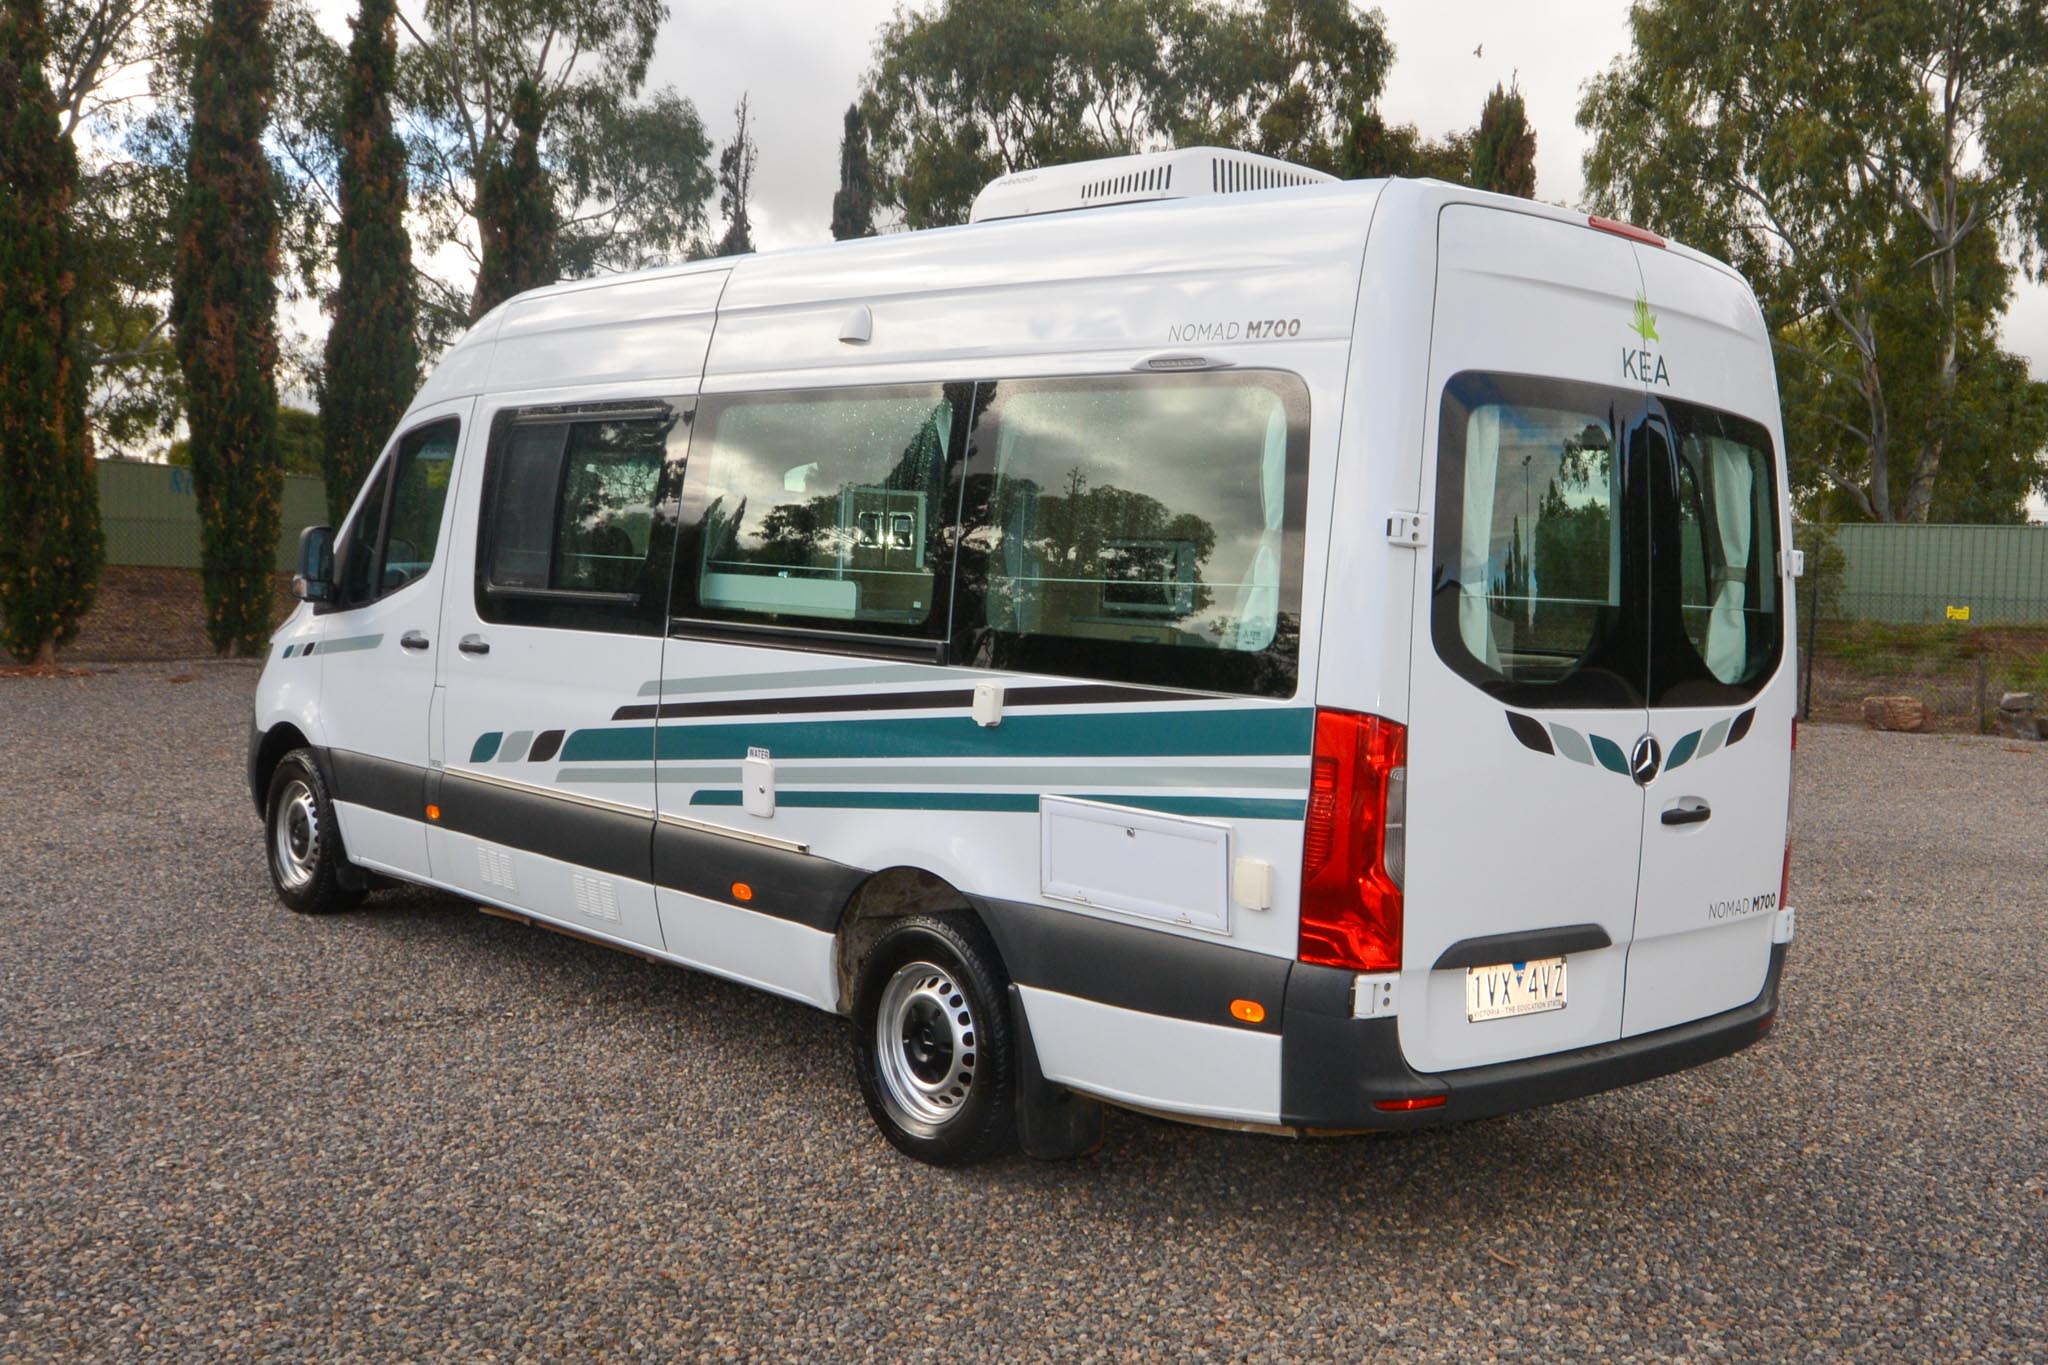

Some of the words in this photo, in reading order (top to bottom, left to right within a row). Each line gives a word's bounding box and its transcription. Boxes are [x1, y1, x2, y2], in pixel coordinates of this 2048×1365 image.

[1168, 321, 1240, 343] NOMAD
[1246, 318, 1302, 339] M700
[1622, 347, 1670, 387] KEA
[750, 748, 769, 760] WATER
[1708, 897, 1750, 921] NOMAD
[1752, 892, 1776, 912] M700
[1475, 970, 1511, 1009] 1VX
[1528, 964, 1563, 1001] 4VZ
